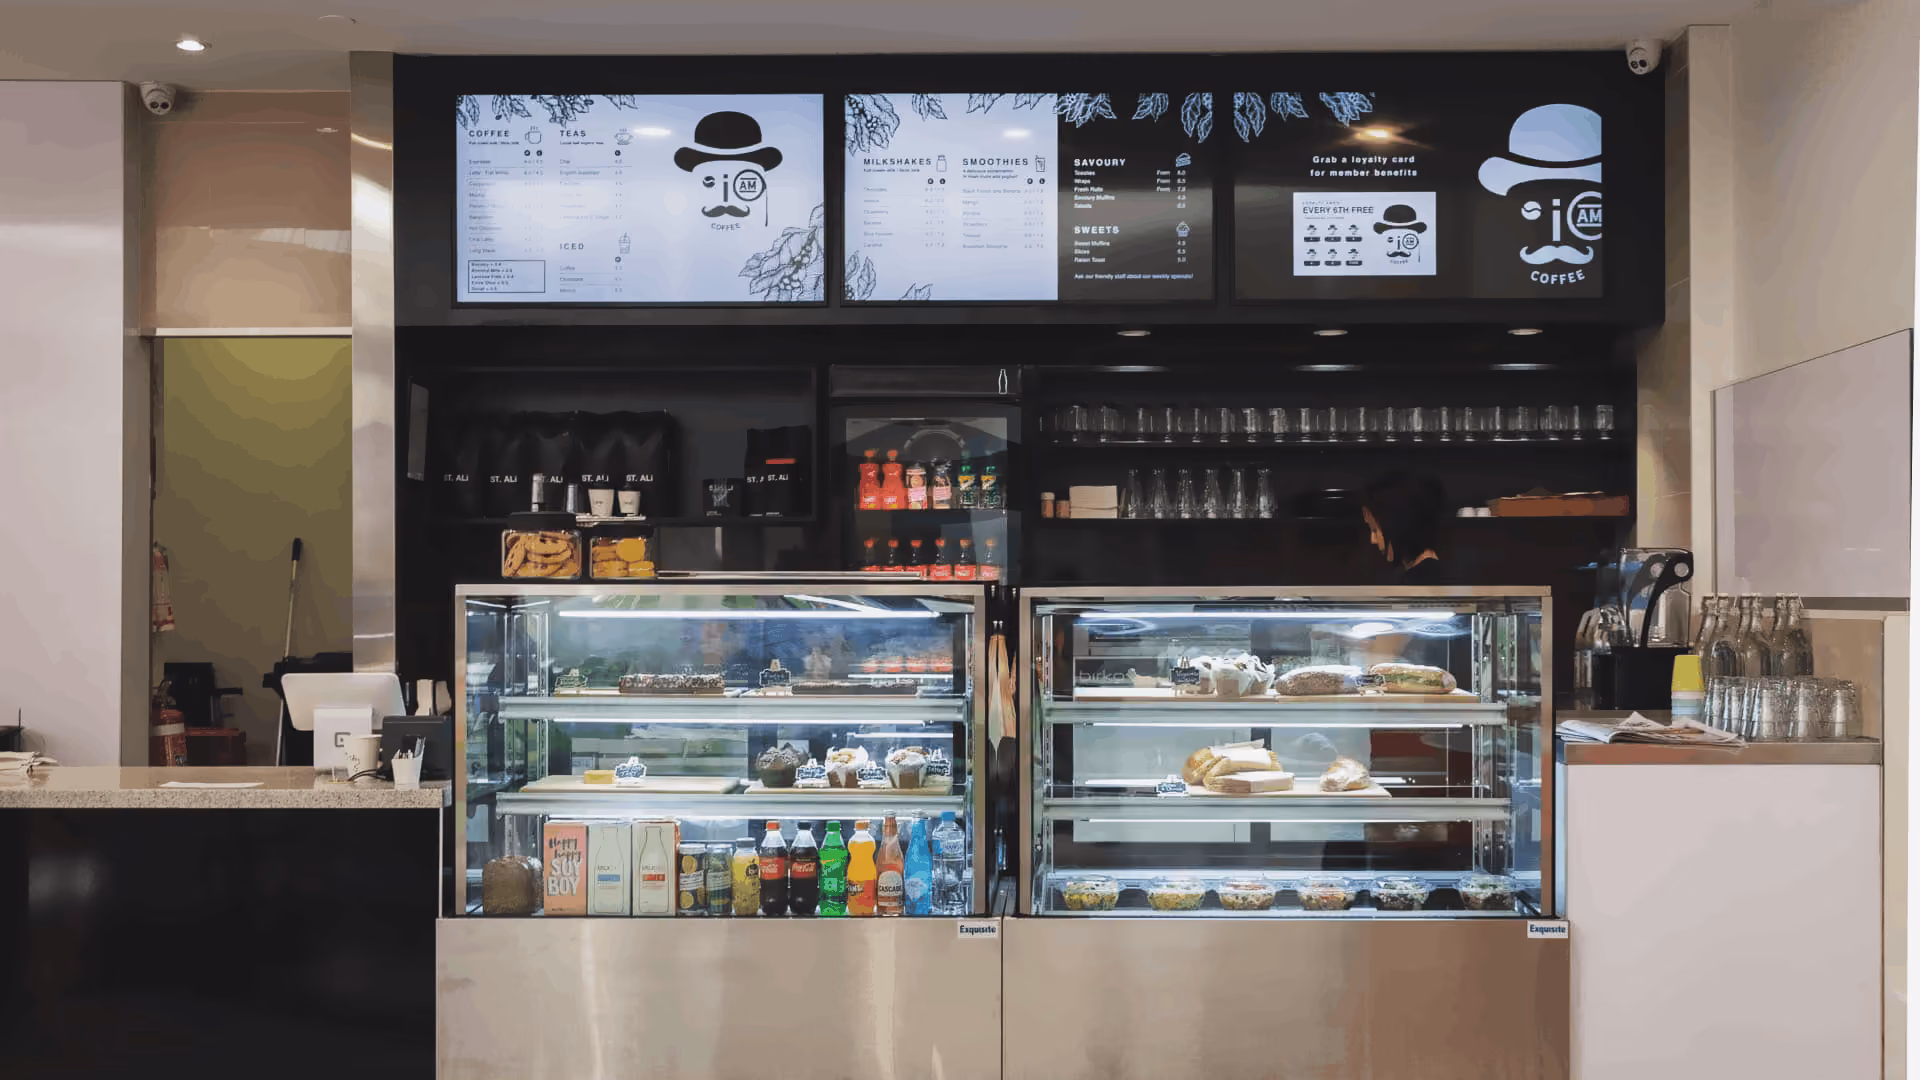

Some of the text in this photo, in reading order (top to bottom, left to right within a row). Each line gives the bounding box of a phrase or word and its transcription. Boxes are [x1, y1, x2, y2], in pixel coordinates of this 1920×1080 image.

[863, 158, 932, 166] MILKSHAKES
[962, 158, 1029, 166] SMOOTHIES
[1073, 158, 1126, 167] SAVOURY
[1312, 155, 1337, 163] Grab
[1351, 155, 1388, 165] loyalty
[1392, 155, 1415, 163] card
[1329, 169, 1370, 177] member
[1374, 169, 1417, 177] benefits
[740, 181, 756, 190] AM
[1302, 206, 1374, 214] EVERY 6TH FREE
[1577, 209, 1602, 223] AM
[711, 223, 741, 231] COFFEE
[1073, 226, 1120, 234] SWEETS
[1530, 269, 1585, 285] COFFEE
[490, 475, 502, 483] ST.
[581, 474, 594, 482] ST.
[626, 474, 638, 482] ST.
[551, 860, 581, 876] SOY
[547, 876, 581, 896] BOY
[959, 924, 997, 936] Exquisite
[1529, 924, 1566, 936] Exquisite
